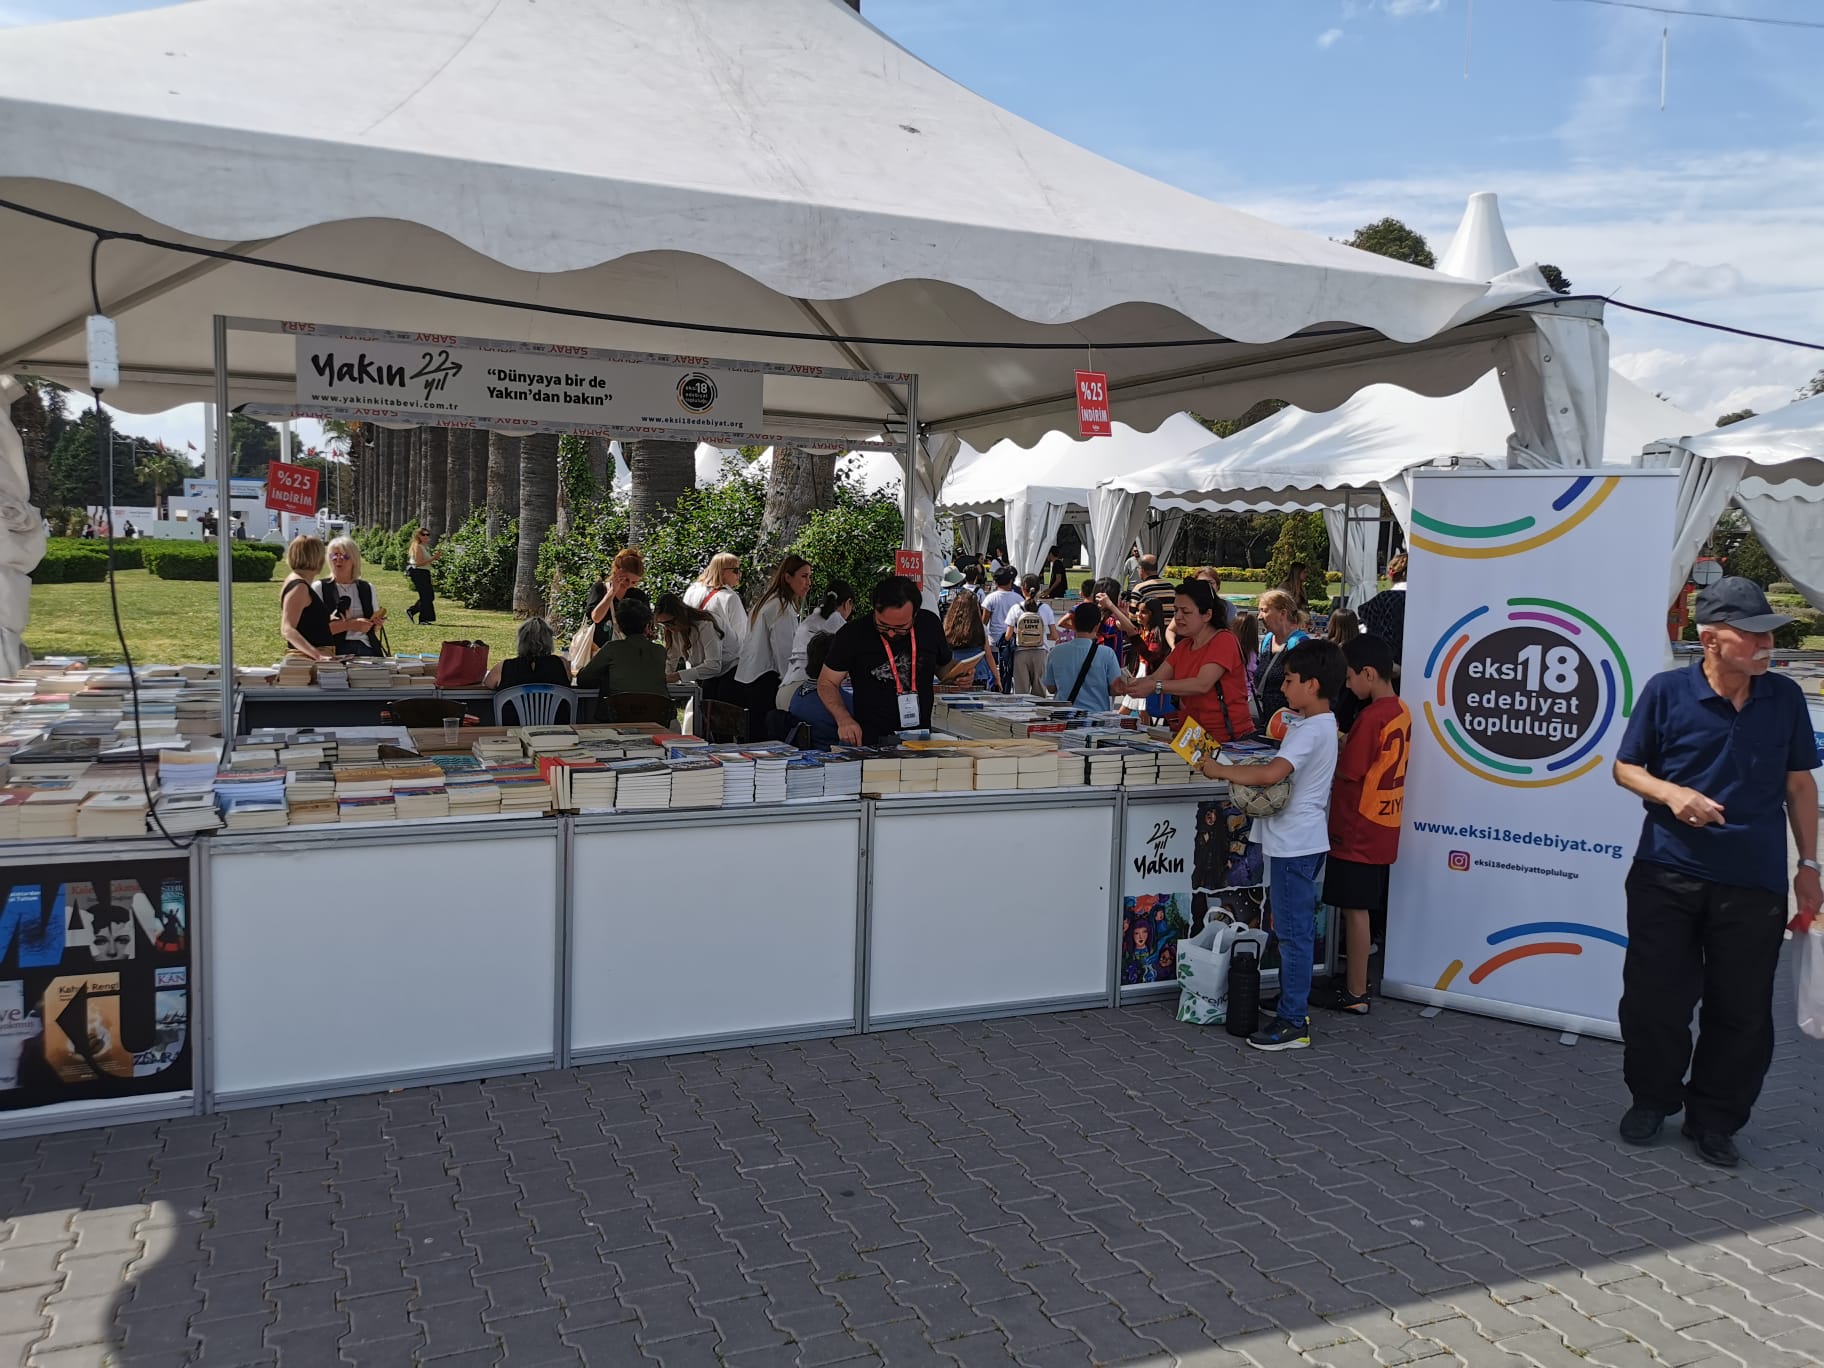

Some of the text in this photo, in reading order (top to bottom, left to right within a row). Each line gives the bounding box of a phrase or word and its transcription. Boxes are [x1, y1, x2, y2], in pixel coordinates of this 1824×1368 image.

[565, 373, 584, 388] bir
[588, 375, 607, 389] de
[1080, 381, 1103, 401] %25
[311, 393, 460, 411] www.yakinkitabevi.com.tr
[641, 415, 744, 429] www.eksi18edebiyat.org
[277, 470, 311, 490] %25
[271, 488, 312, 506] İNDİRİM
[900, 556, 920, 569] %25
[1466, 690, 1580, 716] edebiyat
[1464, 712, 1578, 741] topluluğu
[1413, 818, 1624, 860] www.eksi18edebiyat.org
[1474, 858, 1580, 880] eksi18edebiyattoplulugu
